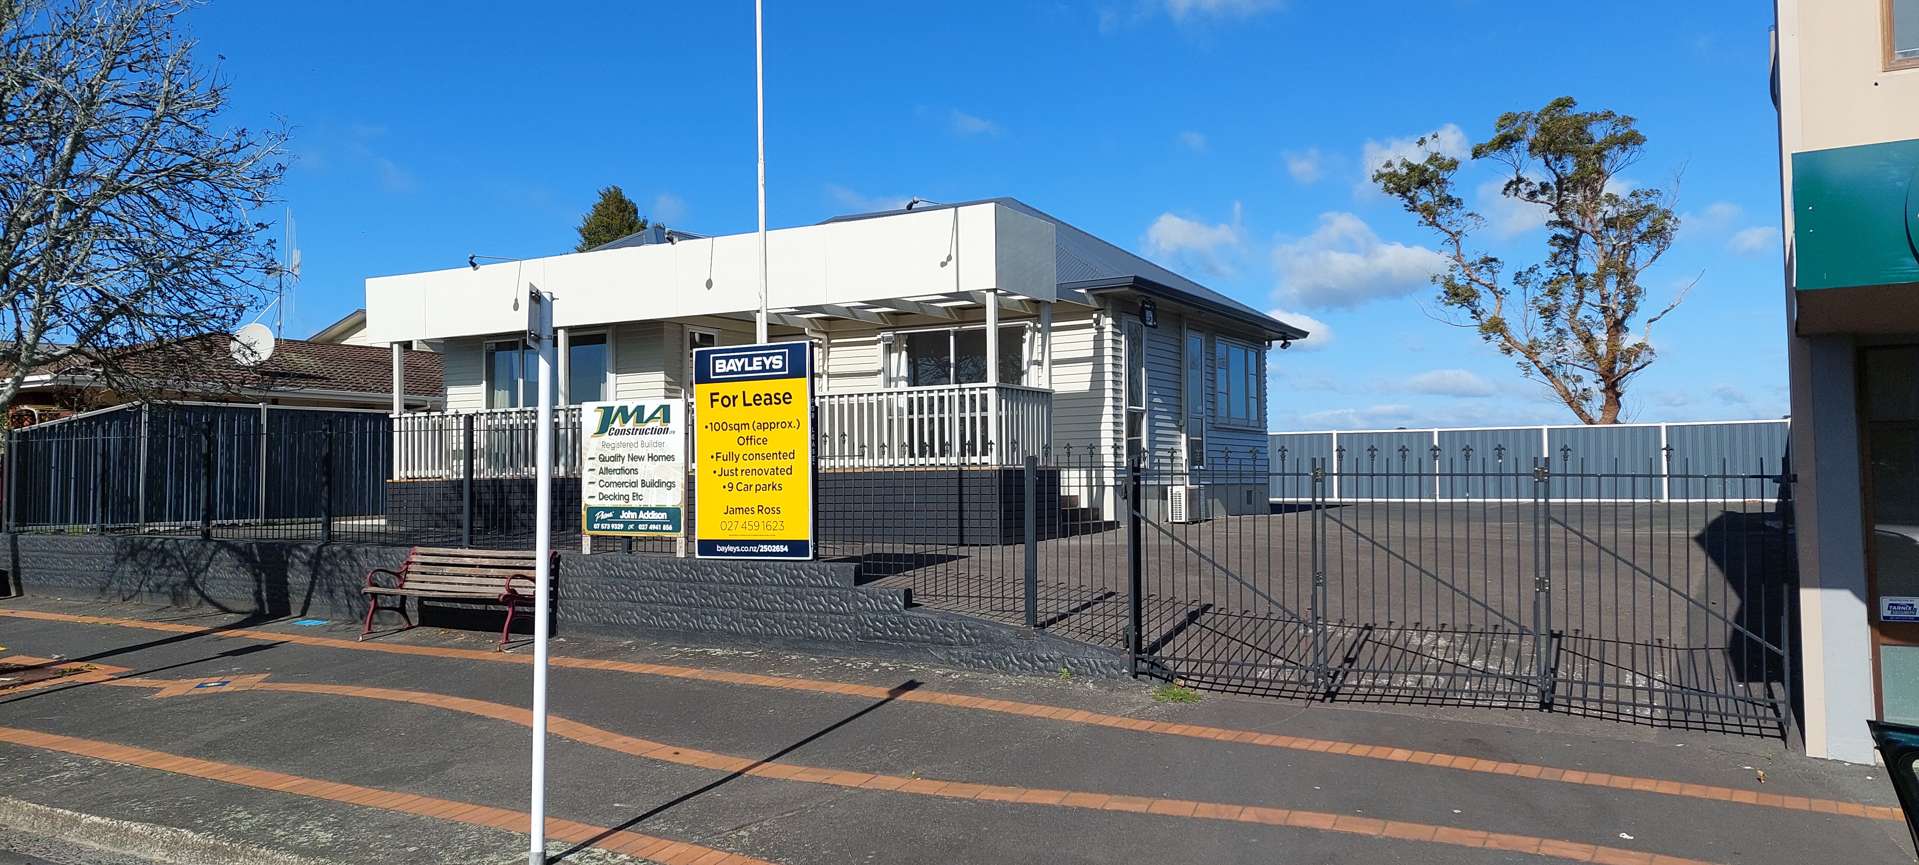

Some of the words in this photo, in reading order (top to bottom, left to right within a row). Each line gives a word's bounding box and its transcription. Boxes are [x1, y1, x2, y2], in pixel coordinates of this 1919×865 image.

[715, 355, 783, 373] BAYLEYS
[709, 392, 738, 408] For
[742, 390, 793, 407] Lease
[591, 404, 671, 437] JMA
[752, 418, 800, 432] (approx.)
[608, 426, 670, 437] Construction
[601, 440, 639, 450] Registered
[640, 440, 665, 448] Builder
[737, 435, 768, 446] Office
[598, 453, 625, 464] Quality
[627, 453, 645, 463] New
[647, 452, 676, 462] Homes
[715, 451, 740, 463] Fully
[742, 449, 795, 461] consented
[598, 466, 639, 476] Alterations
[717, 466, 739, 477] Just
[740, 465, 793, 476] renovated
[598, 479, 638, 489] Comercial
[640, 479, 676, 491] Buildings
[727, 482, 734, 492] 9
[736, 481, 753, 492] Car
[755, 481, 783, 493] parks
[598, 492, 630, 503] Decking
[632, 492, 644, 501] Etc
[619, 510, 637, 520] John
[639, 509, 668, 520] Addison
[723, 505, 755, 515] James
[757, 504, 781, 515] Ross
[720, 520, 738, 531] 027
[741, 520, 760, 531] 459
[762, 520, 785, 531] 1623
